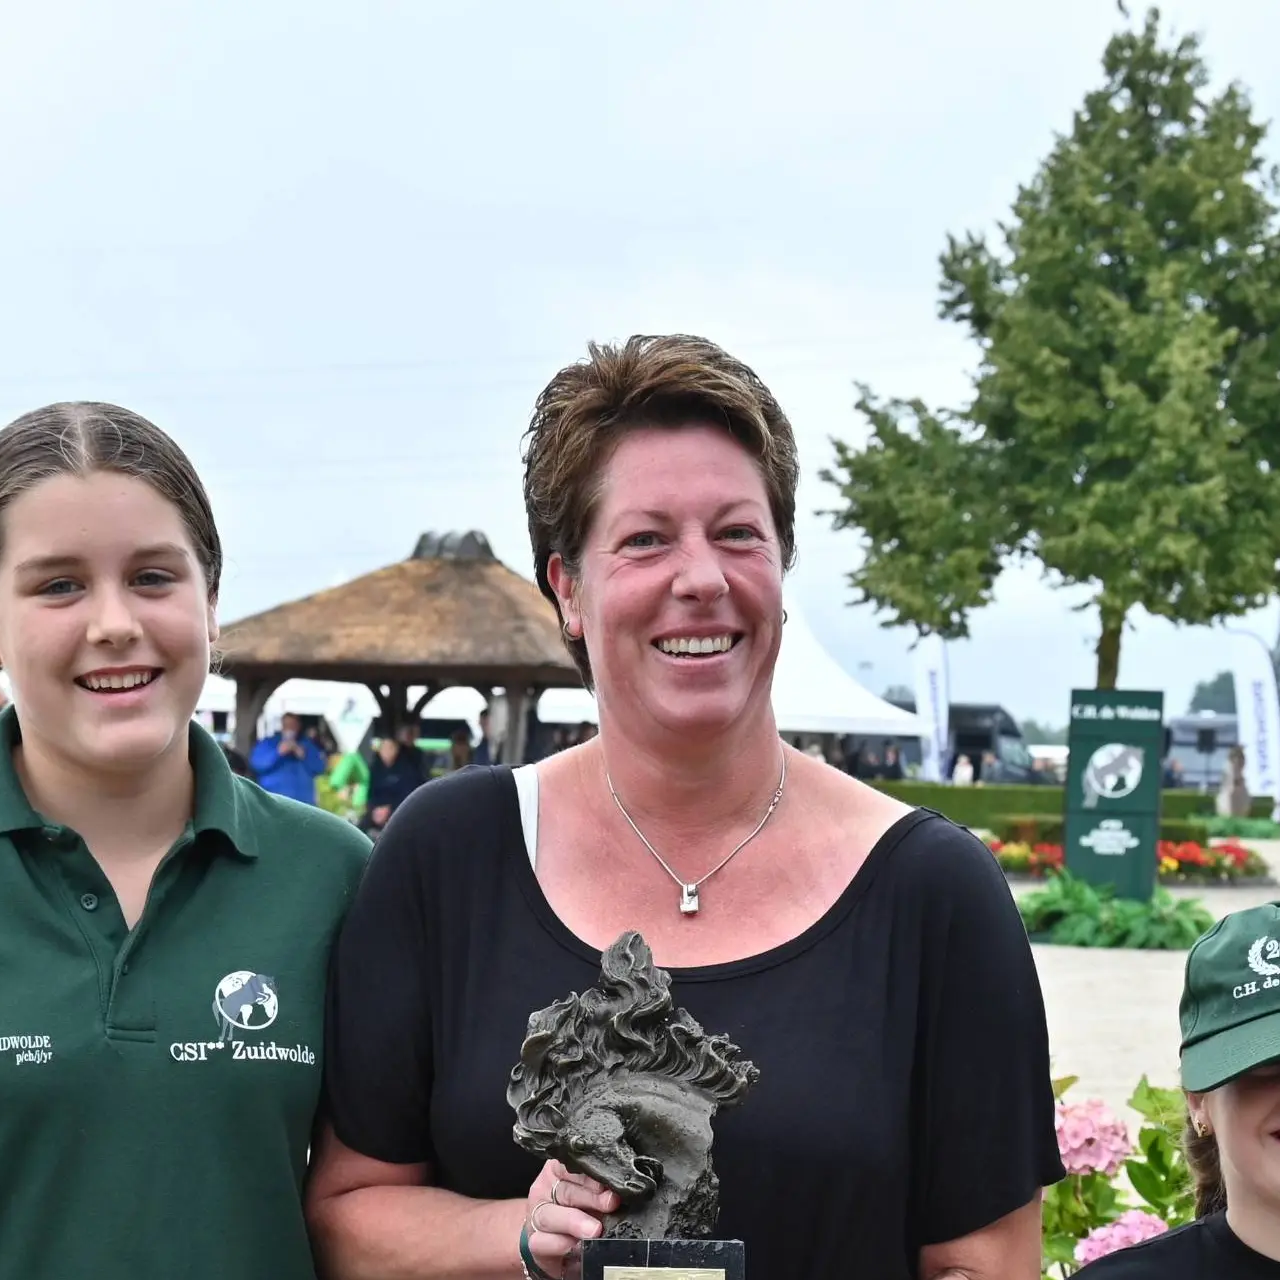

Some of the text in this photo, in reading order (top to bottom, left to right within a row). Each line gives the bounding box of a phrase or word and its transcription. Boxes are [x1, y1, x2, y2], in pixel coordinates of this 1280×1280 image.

[1233, 981, 1260, 999] C.H.
[1263, 976, 1280, 989] de
[232, 1041, 316, 1065] Zuidwolde
